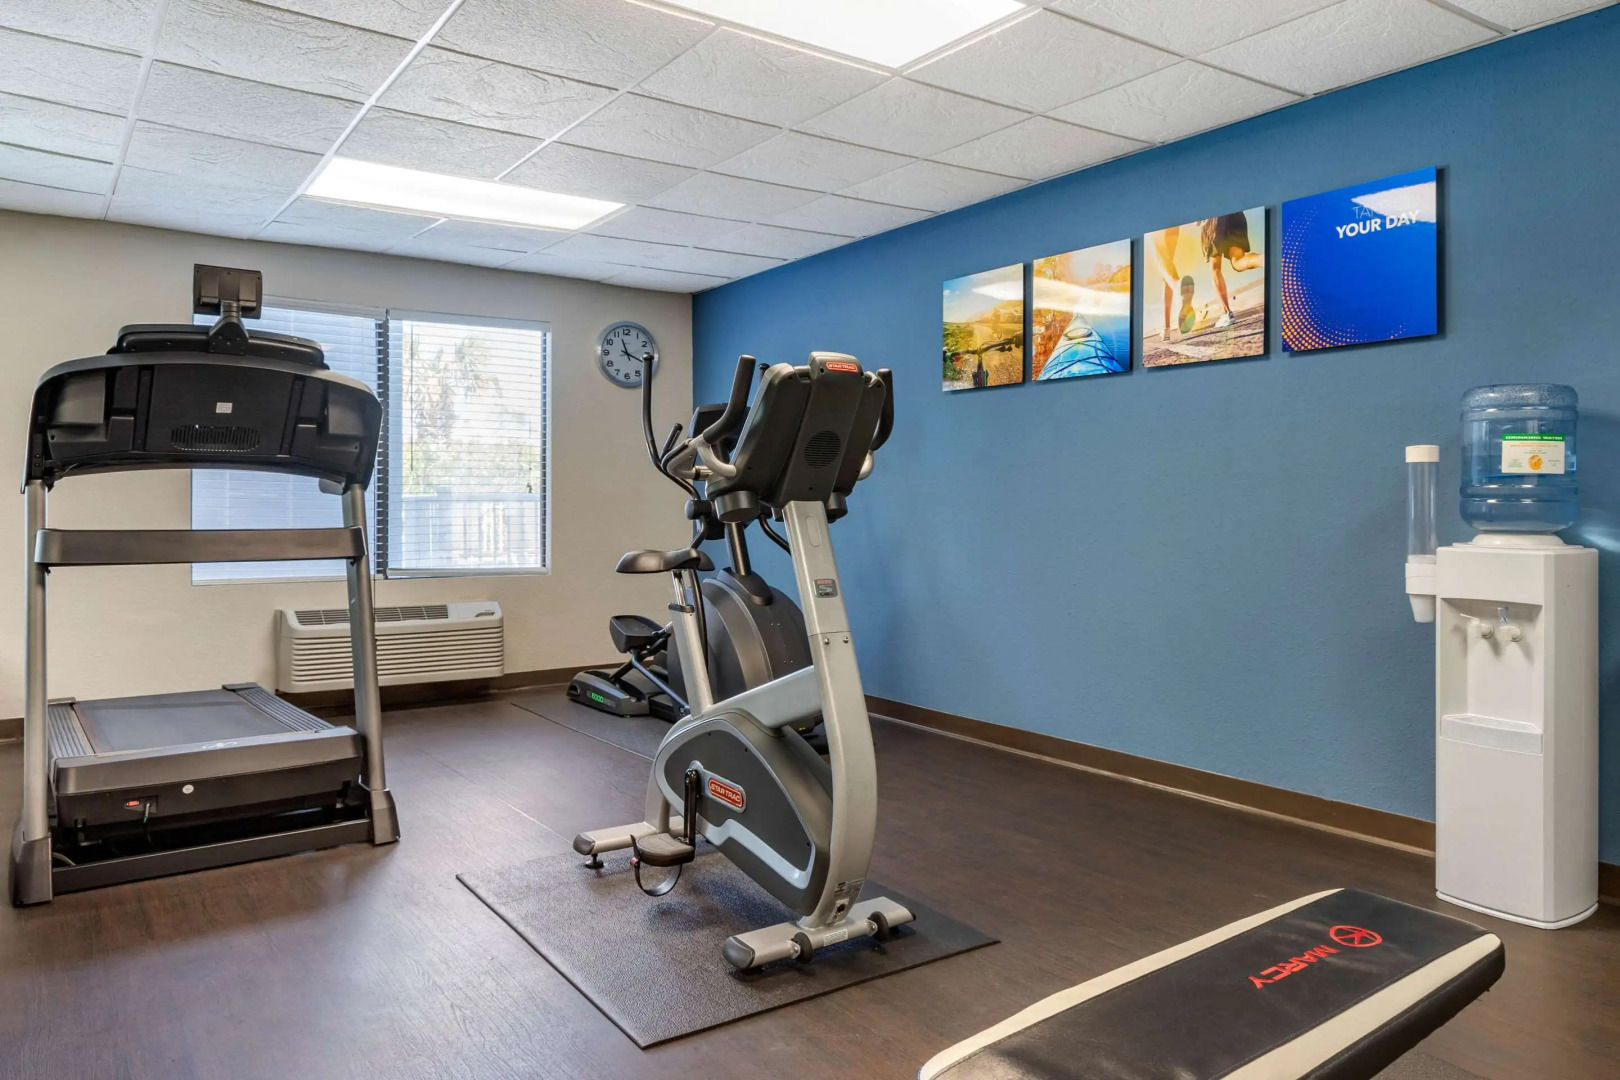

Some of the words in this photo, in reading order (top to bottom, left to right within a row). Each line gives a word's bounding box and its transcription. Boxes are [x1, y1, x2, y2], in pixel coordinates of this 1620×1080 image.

[1336, 218, 1382, 239] YOUR
[1385, 210, 1420, 230] DAY
[623, 328, 630, 336] 12
[710, 783, 725, 796] STAR
[725, 789, 741, 803] TRAC
[1247, 944, 1341, 990] MARCY
